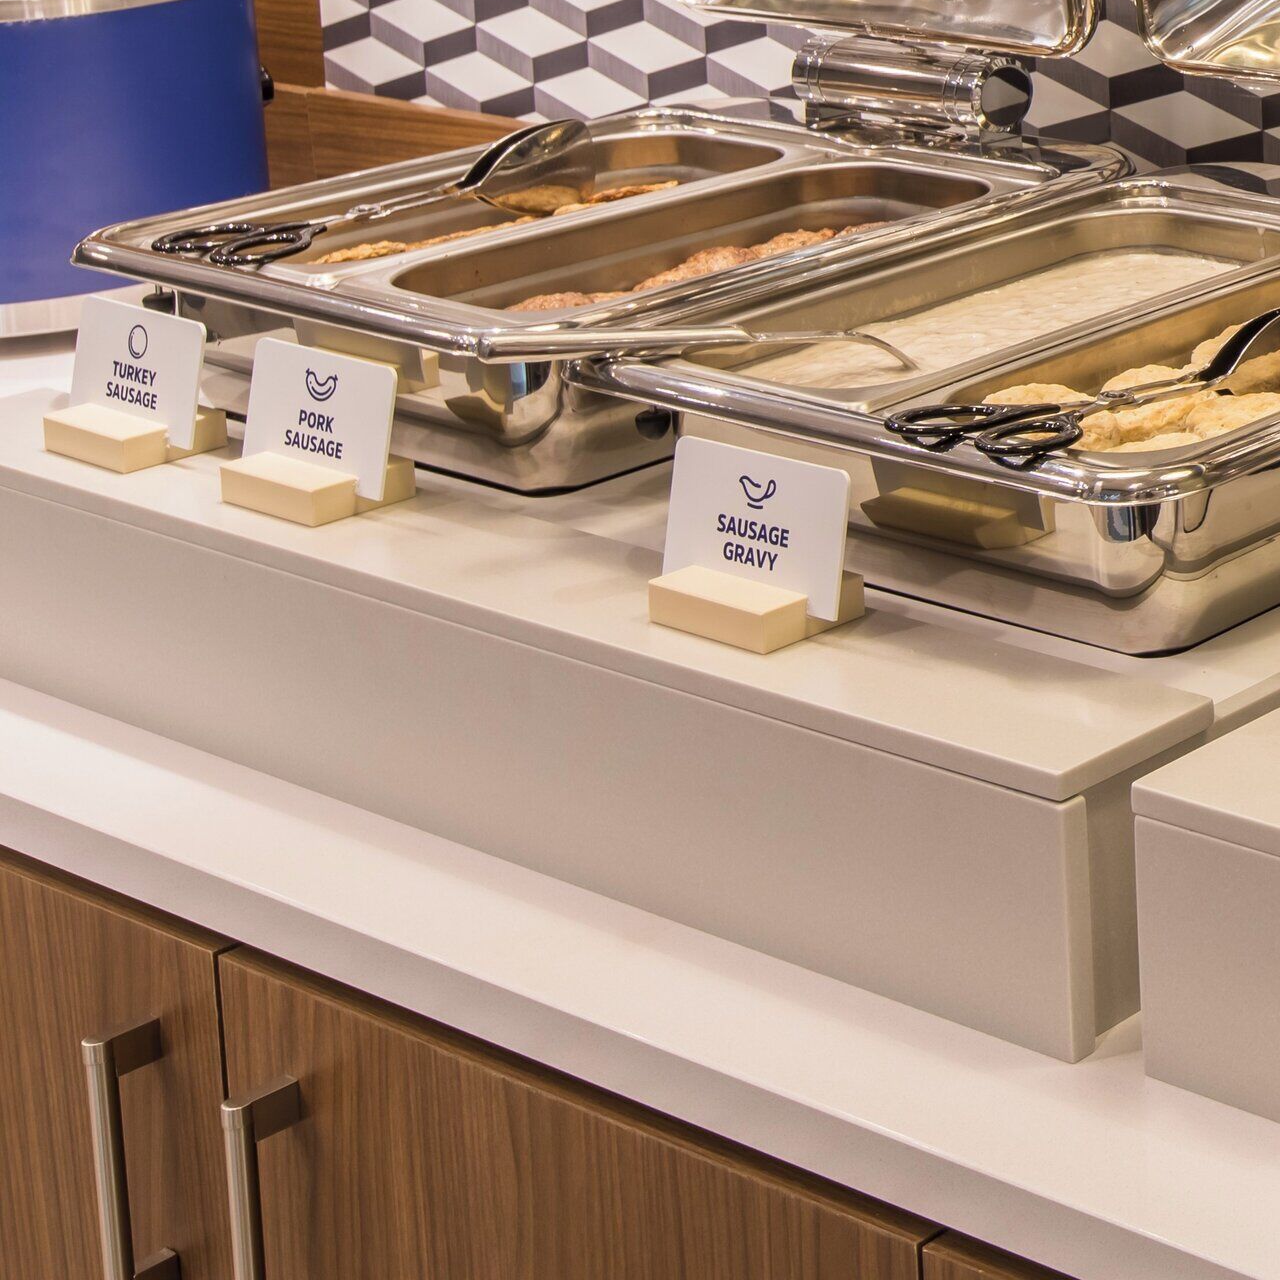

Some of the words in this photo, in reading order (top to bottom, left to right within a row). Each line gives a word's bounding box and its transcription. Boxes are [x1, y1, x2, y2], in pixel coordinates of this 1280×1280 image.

[112, 360, 157, 387] TURKEY
[105, 381, 158, 410] SAUSAGE
[298, 409, 335, 434] PORK
[284, 429, 343, 460] SAUSAGE
[716, 513, 790, 548] SAUSAGE
[722, 541, 778, 571] GRAVY
